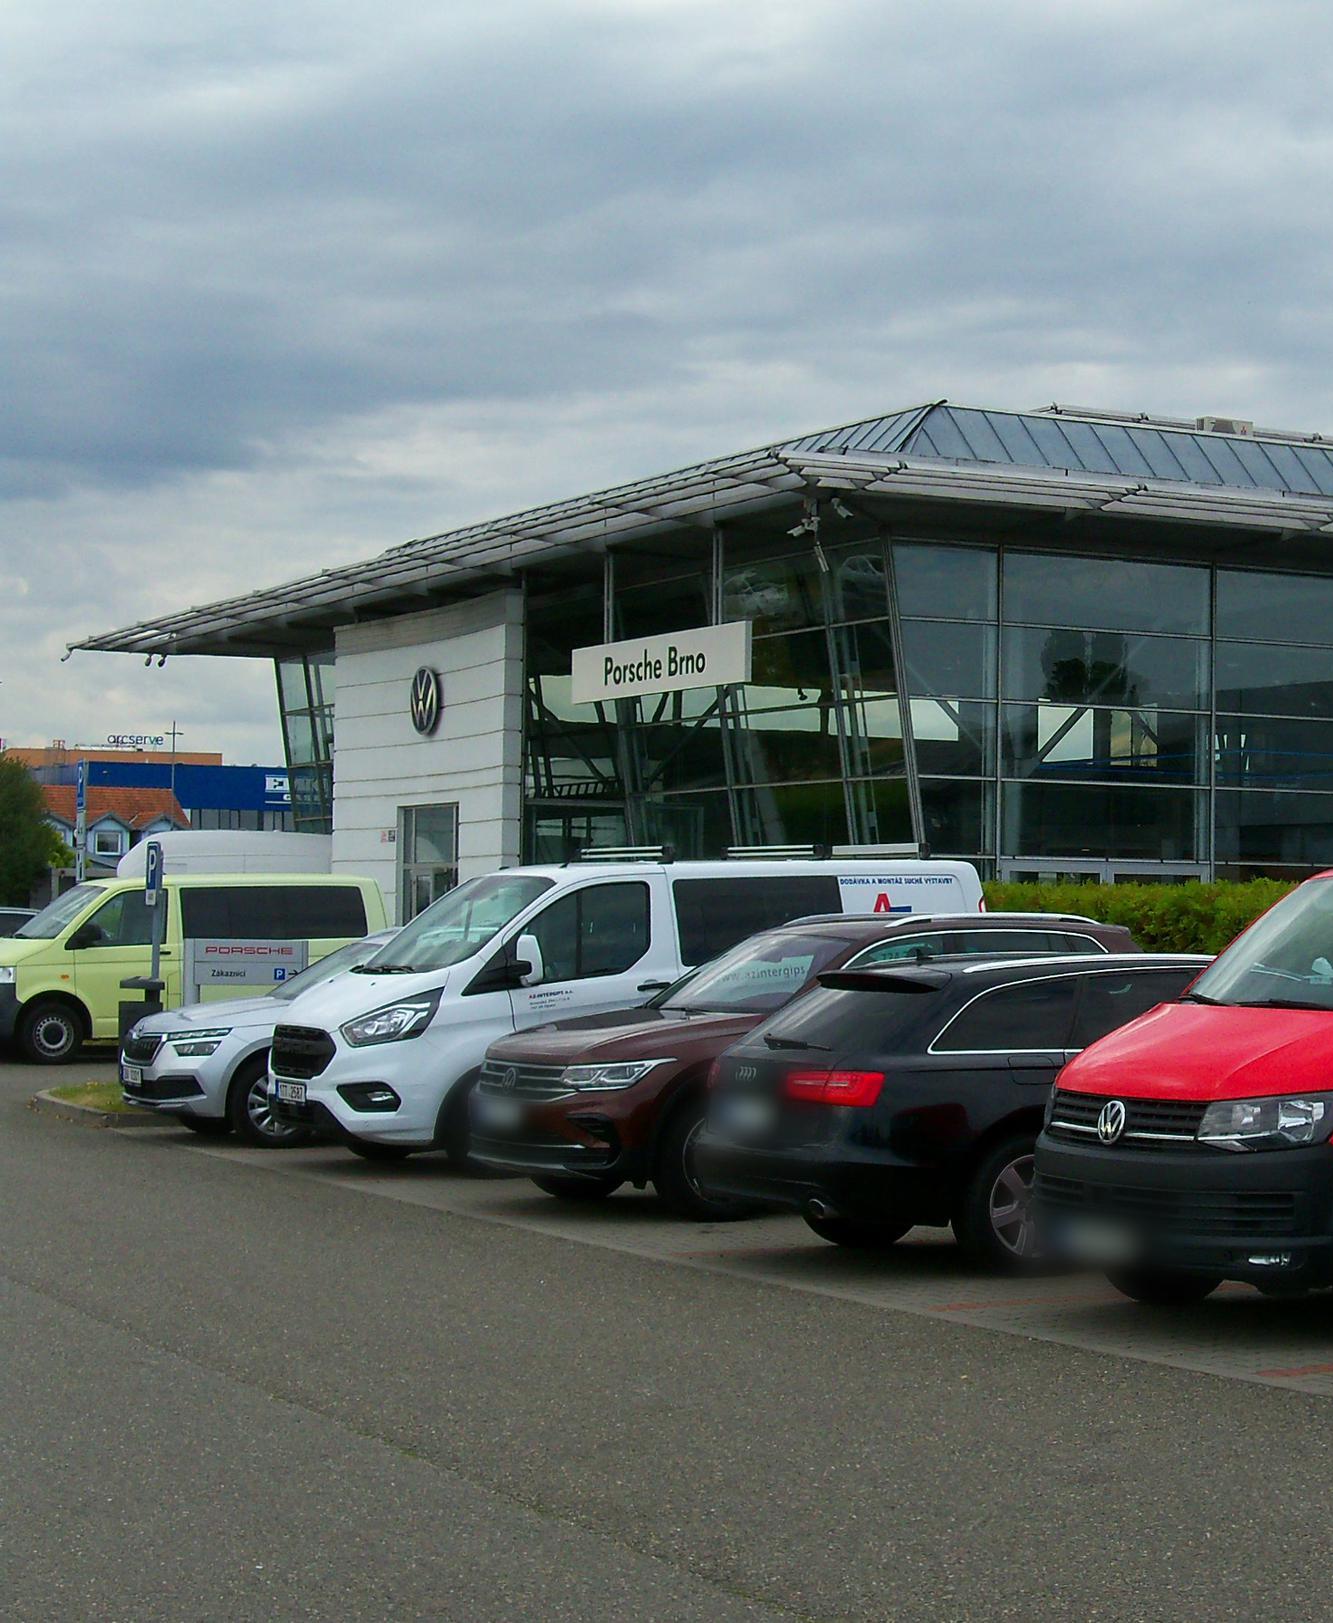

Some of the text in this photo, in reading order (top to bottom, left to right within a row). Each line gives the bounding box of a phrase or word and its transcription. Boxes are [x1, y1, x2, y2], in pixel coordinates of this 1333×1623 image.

[604, 646, 706, 686] Porsche Brno
[107, 735, 164, 745] arcserve
[205, 946, 294, 955] PORSCHE
